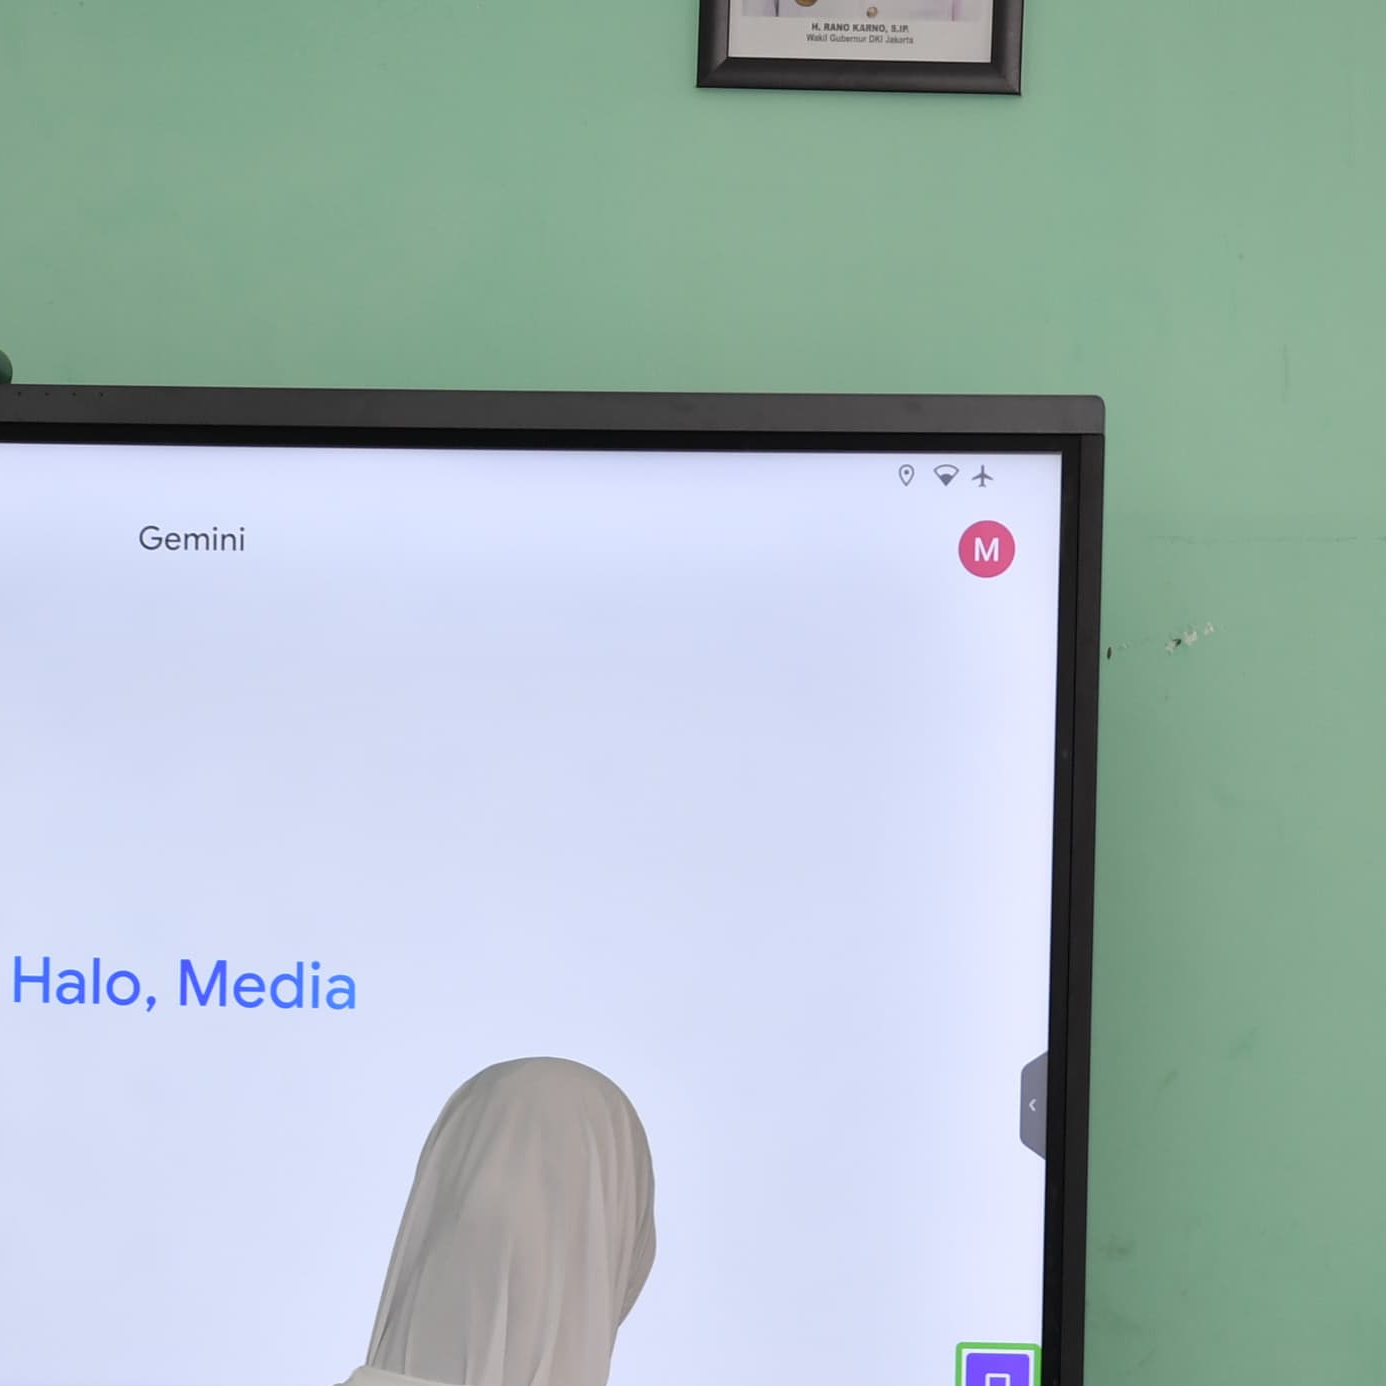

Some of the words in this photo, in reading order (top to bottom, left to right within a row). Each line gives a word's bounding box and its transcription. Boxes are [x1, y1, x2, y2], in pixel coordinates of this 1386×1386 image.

[806, 33, 828, 42] Wakil
[830, 34, 867, 43] Gubernur
[869, 35, 884, 44] DKI
[886, 36, 914, 44] Jakarta
[811, 23, 821, 32] H.
[824, 23, 850, 32] RANO
[853, 24, 888, 34] KARNO,
[138, 525, 246, 552] Gemini
[974, 537, 1000, 562] M
[13, 955, 157, 1013] Halo,
[179, 959, 356, 1010] Media
